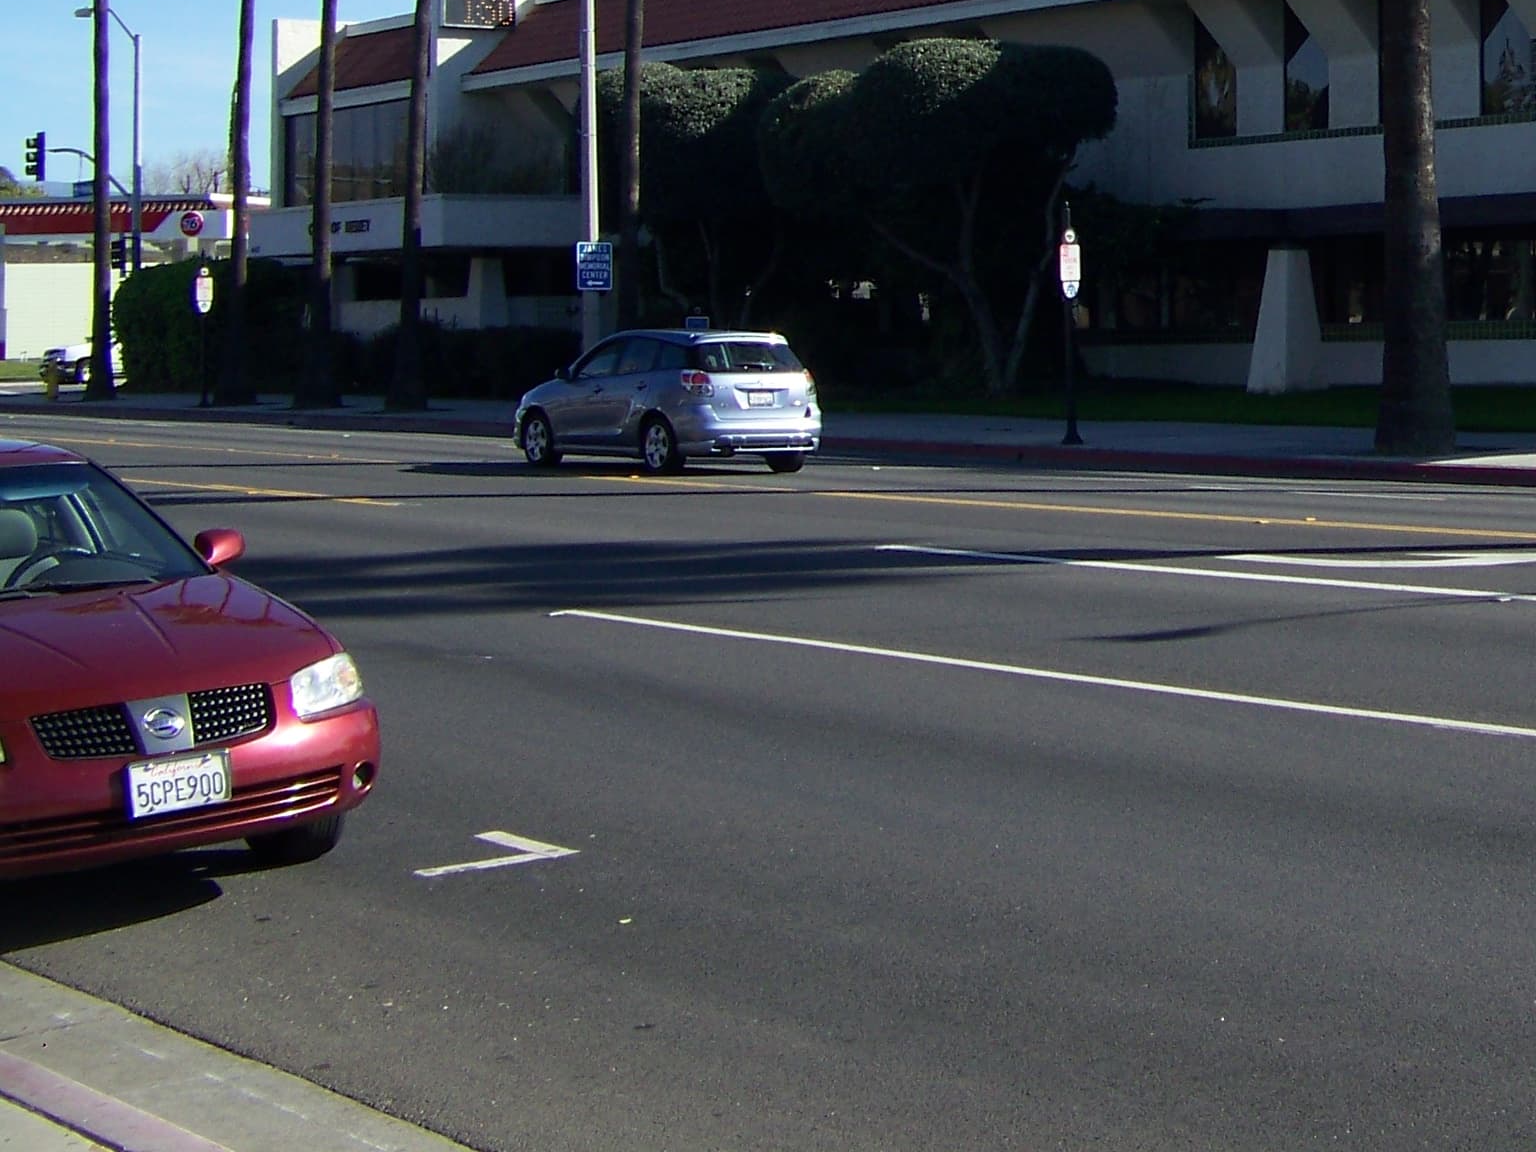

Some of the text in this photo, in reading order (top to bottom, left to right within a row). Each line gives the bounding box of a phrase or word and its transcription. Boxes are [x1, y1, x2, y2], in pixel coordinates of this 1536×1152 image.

[182, 217, 200, 231] 76
[582, 271, 608, 279] CENTER
[137, 771, 223, 808] 5CPE900
